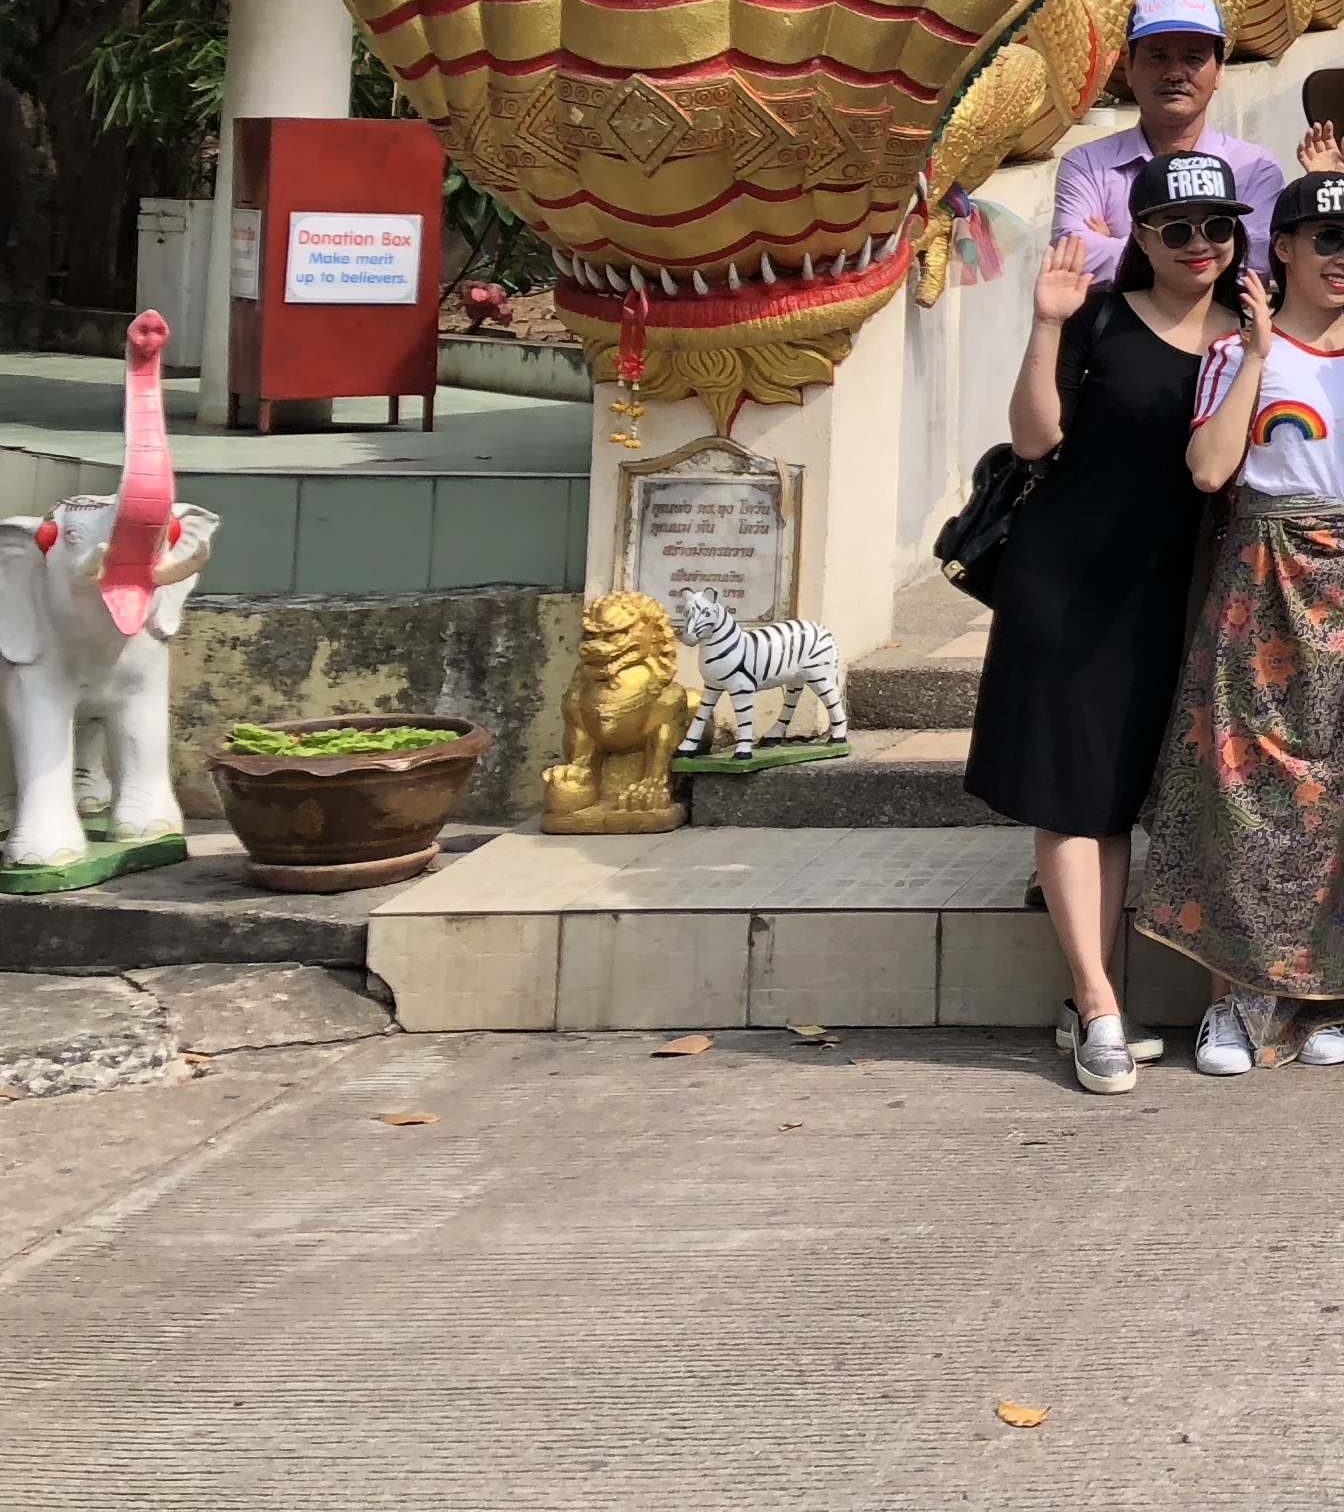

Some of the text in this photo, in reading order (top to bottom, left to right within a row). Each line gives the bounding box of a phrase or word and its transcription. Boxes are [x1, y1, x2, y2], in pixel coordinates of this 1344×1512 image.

[1166, 169, 1226, 200] FRESH
[298, 229, 411, 247] Donation Box
[308, 252, 394, 265] Make merit
[295, 271, 409, 286] up to believers.
